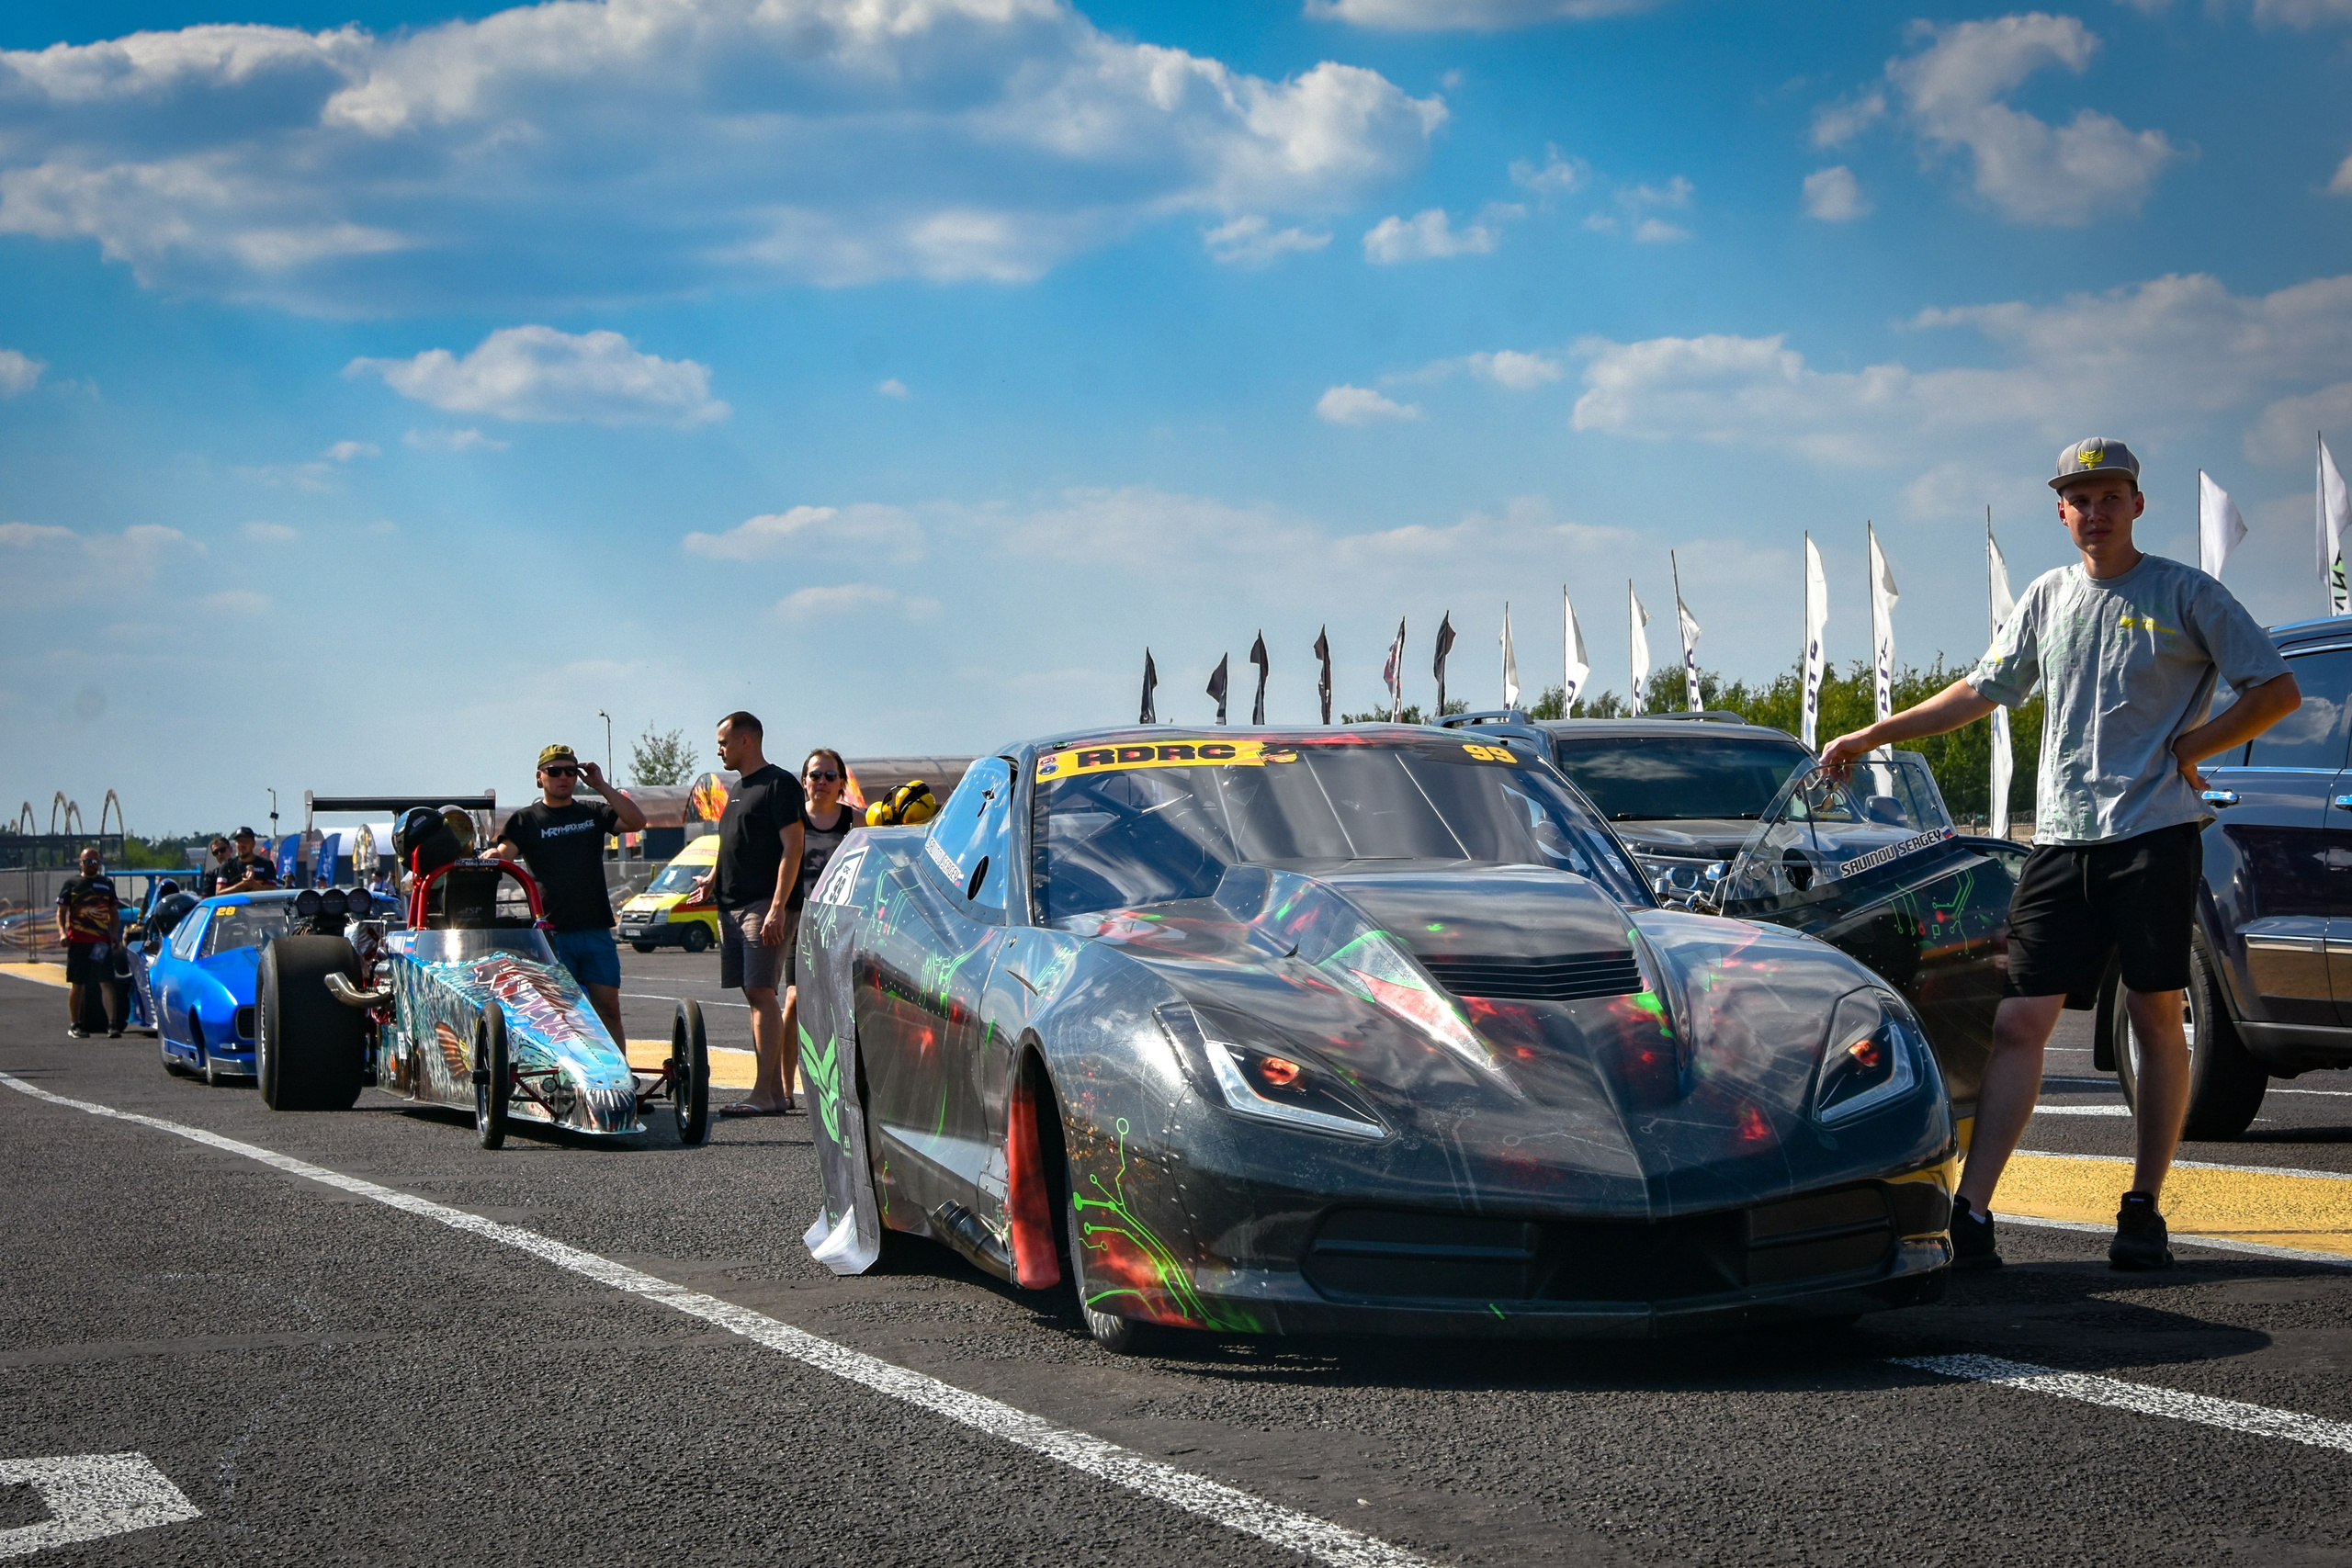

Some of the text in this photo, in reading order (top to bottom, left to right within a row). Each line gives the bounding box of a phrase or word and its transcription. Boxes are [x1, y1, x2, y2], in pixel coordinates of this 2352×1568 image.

[1076, 744, 1236, 768] RDRC
[1462, 744, 1518, 764] 99
[1897, 829, 1942, 855] SERGEY
[829, 875, 847, 904] 99
[216, 906, 236, 917] 28
